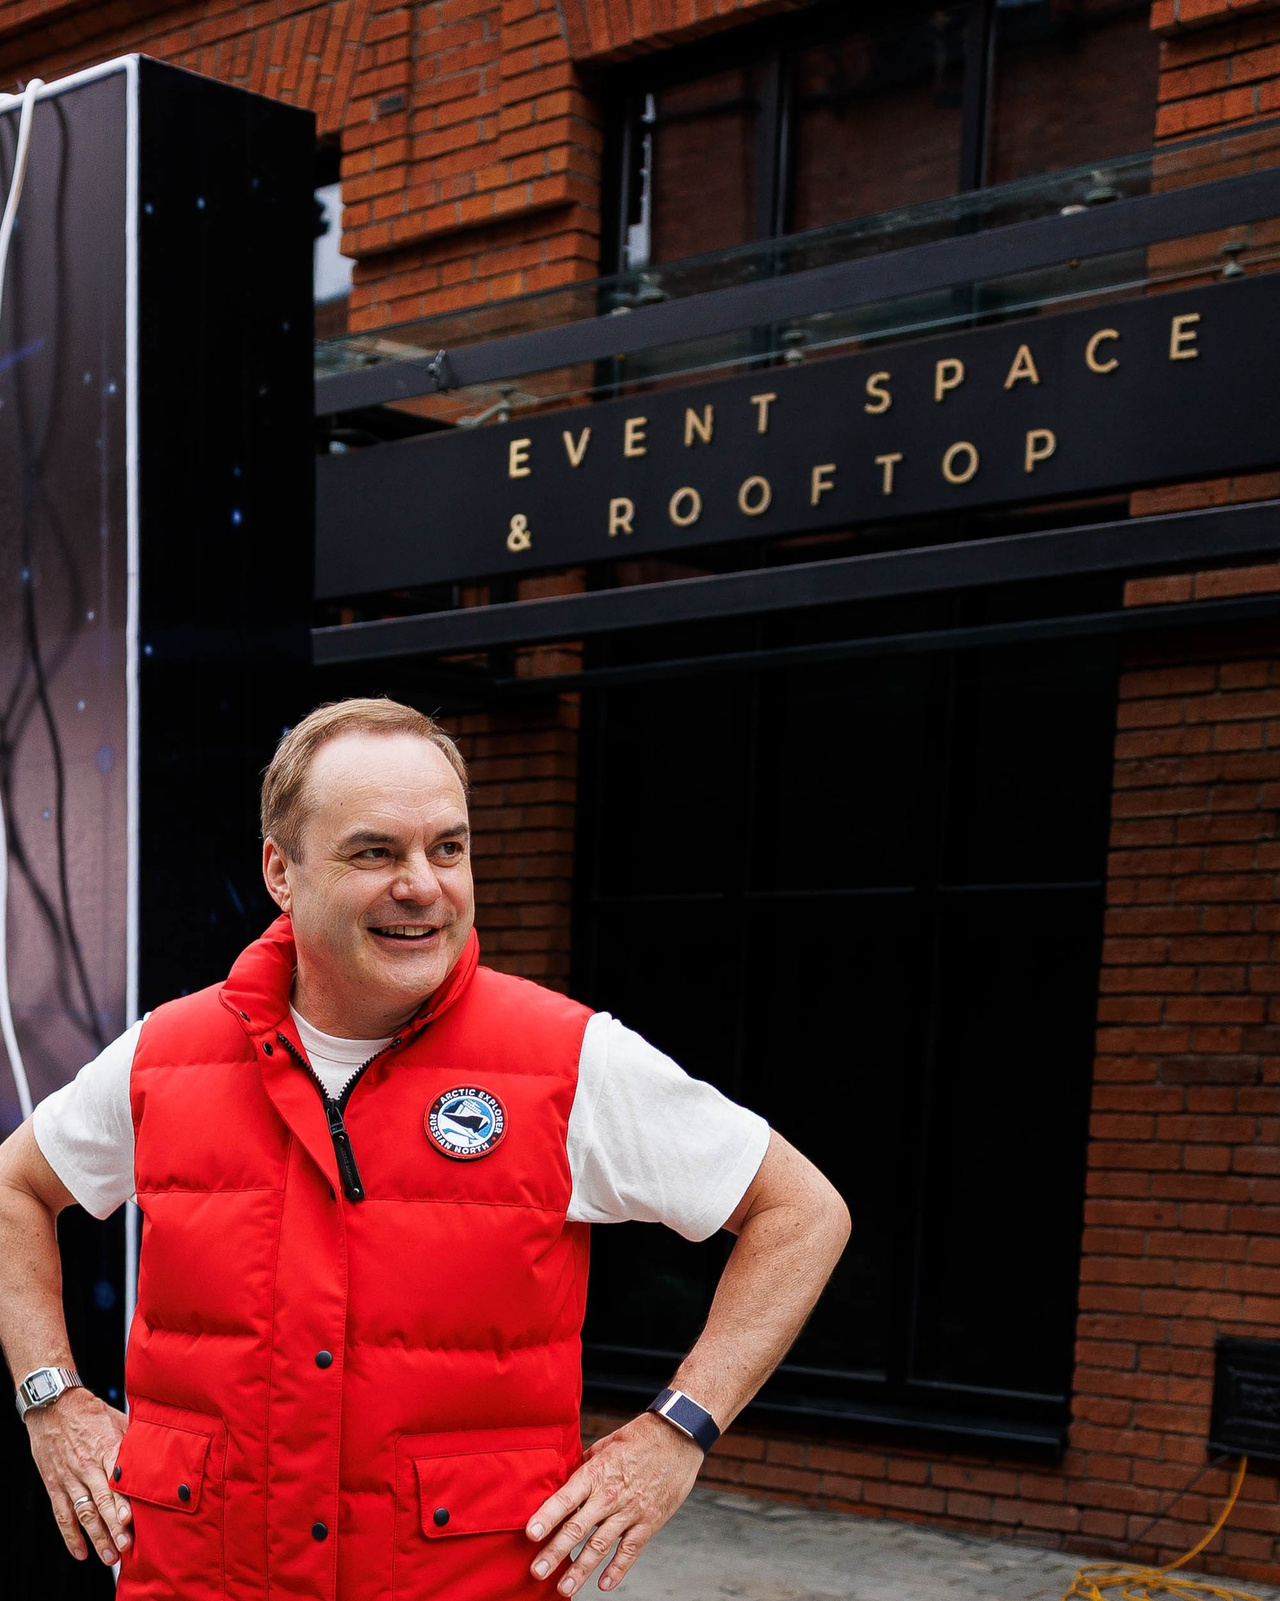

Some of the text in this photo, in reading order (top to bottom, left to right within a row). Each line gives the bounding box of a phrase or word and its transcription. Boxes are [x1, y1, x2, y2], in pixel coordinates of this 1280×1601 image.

[507, 312, 1202, 478] EVENT SPACE
[506, 428, 1057, 552] & ROOFTOP
[429, 1113, 489, 1154] RUSSIAN NORTH
[439, 1088, 504, 1134] ARCTIC EXPLORER
